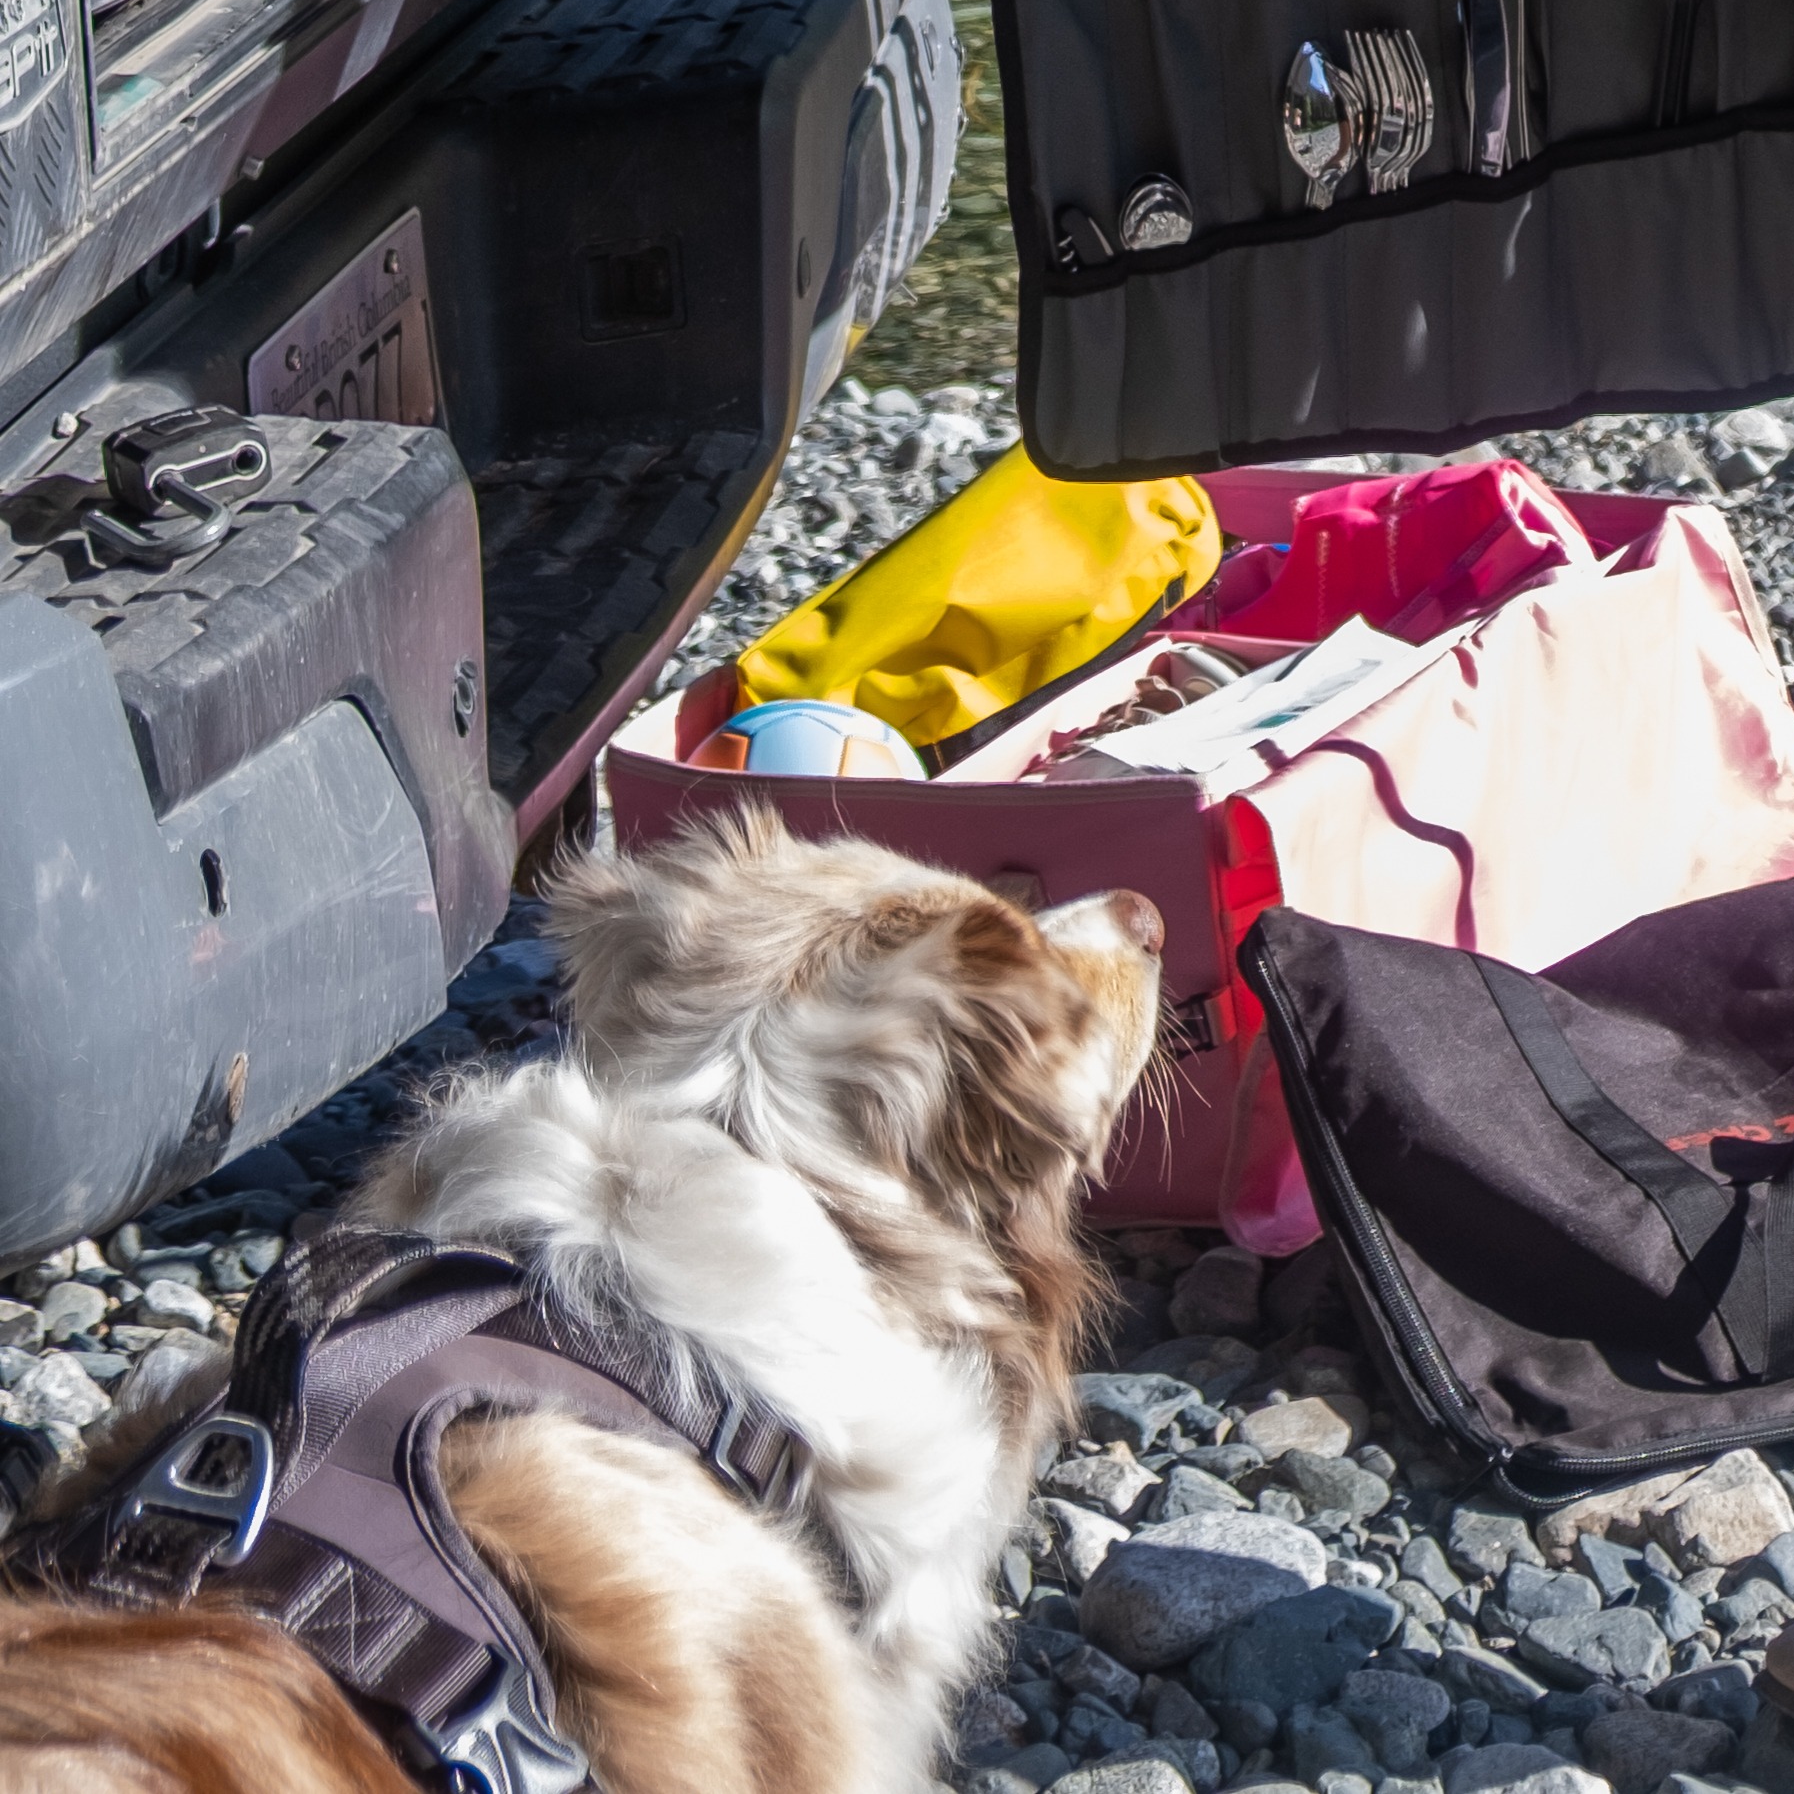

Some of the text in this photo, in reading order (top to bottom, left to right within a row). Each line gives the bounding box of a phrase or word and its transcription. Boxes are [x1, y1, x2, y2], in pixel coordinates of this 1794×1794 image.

[271, 275, 412, 411] Beautiful British Columbia
